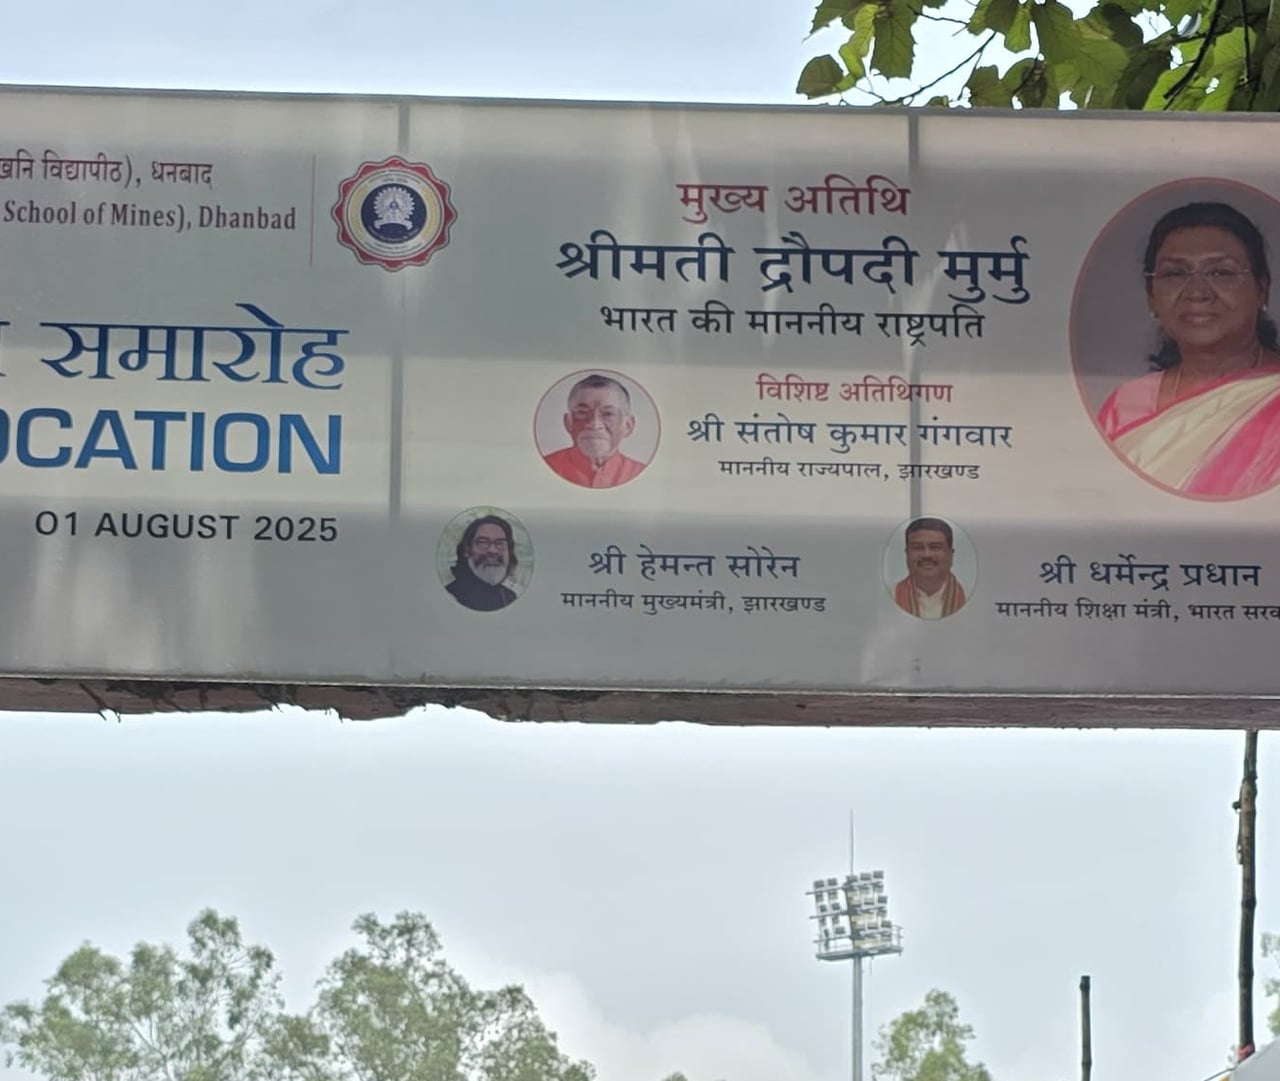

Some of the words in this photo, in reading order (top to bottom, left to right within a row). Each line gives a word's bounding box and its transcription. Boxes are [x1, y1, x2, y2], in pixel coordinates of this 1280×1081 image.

[41, 149, 141, 188] विद्यापीठ),
[152, 161, 213, 189] धनबाद
[4, 200, 76, 224] School
[83, 202, 106, 225] of
[111, 203, 191, 233] Mines),
[199, 205, 295, 230] Dhanbad
[676, 184, 769, 224] मुख्य
[784, 174, 911, 215] अतिथि
[556, 230, 736, 282] श्रीमती
[752, 231, 920, 294] द्रौपदी
[937, 236, 1032, 304] मुर्मु
[600, 306, 678, 333] भारत
[688, 300, 735, 333] की
[745, 303, 864, 335] माननीय
[875, 305, 985, 346] राष्ट्रपति
[40, 303, 349, 390] समारोह
[755, 373, 830, 403] विशिष्ट
[840, 374, 953, 403] अतिथिगण
[687, 413, 725, 442] श्री
[734, 413, 817, 444] संतोष
[826, 423, 908, 454] कुमार
[917, 416, 1013, 448] गंगवार
[718, 457, 790, 477] माननीय
[797, 461, 889, 481] राज्यपाल,
[897, 463, 981, 480] झारखण्ड
[36, 511, 76, 536] 01
[95, 513, 240, 539] AUGUST
[254, 516, 337, 542] 2025
[589, 545, 627, 575] श्री
[636, 544, 716, 581] हेमन्त
[725, 546, 801, 579] सोरेन
[1040, 555, 1077, 584] श्री
[1090, 554, 1170, 591] धर्मेन्द्र
[1179, 563, 1262, 586] प्रधान
[560, 588, 634, 608] माननीय
[640, 589, 733, 615] मुख्यमंत्री,
[741, 596, 826, 614] झारखण्ड
[995, 598, 1069, 617] माननीय
[1074, 597, 1127, 621] शिक्षा
[1132, 599, 1179, 622] मंत्री,
[1188, 604, 1236, 620] भारत
